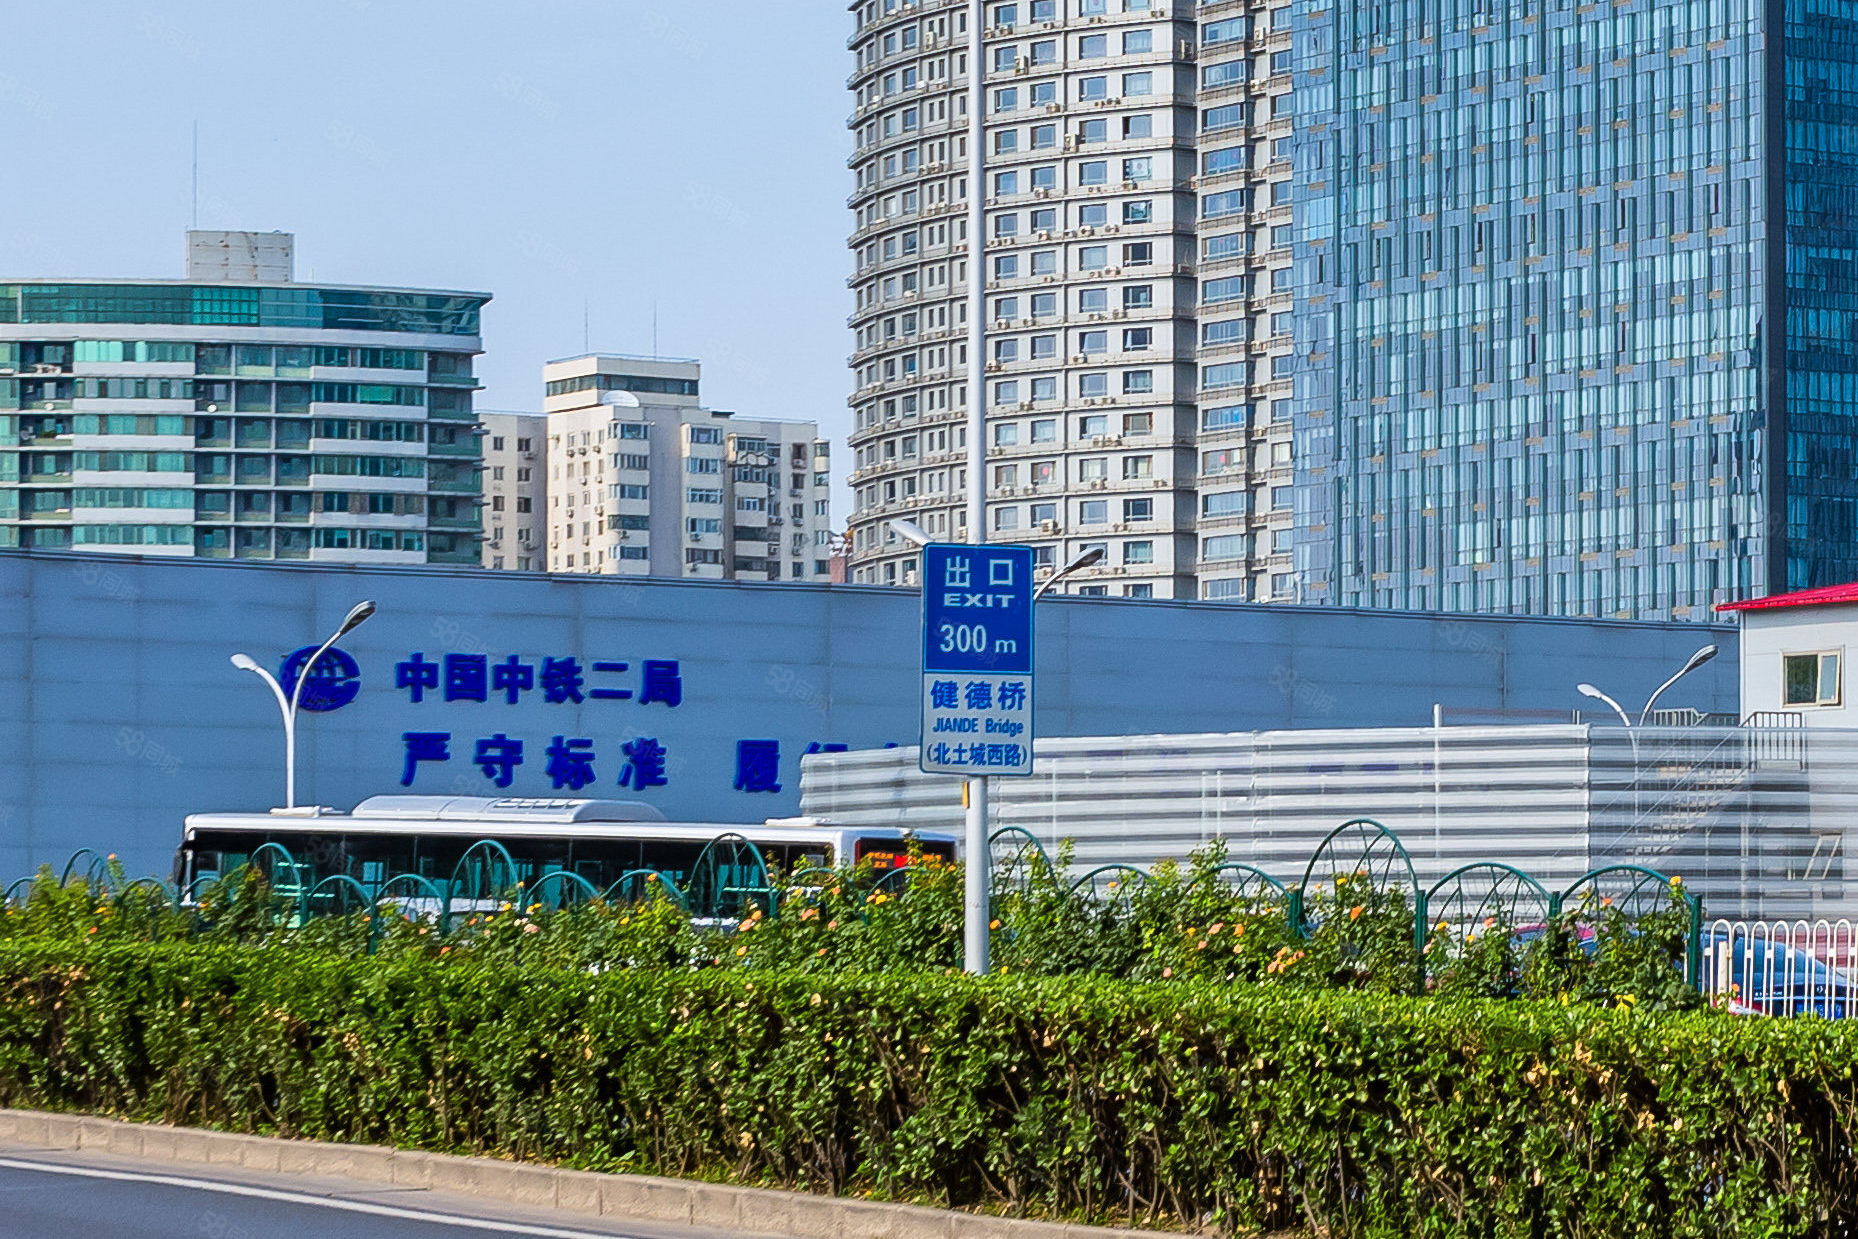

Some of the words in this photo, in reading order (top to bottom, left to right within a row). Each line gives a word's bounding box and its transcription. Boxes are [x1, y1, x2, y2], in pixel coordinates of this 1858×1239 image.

[945, 556, 1014, 587] 出口
[943, 593, 1015, 608] EXIT
[939, 624, 987, 653] 300
[995, 638, 1017, 654] m
[396, 651, 684, 708] 中国中铁二局
[930, 680, 1026, 711] 健德桥
[933, 717, 979, 733] JIANDE
[985, 718, 1024, 737] Bridge
[401, 731, 669, 792] 严守标准
[926, 742, 1028, 767] (北土城西路)
